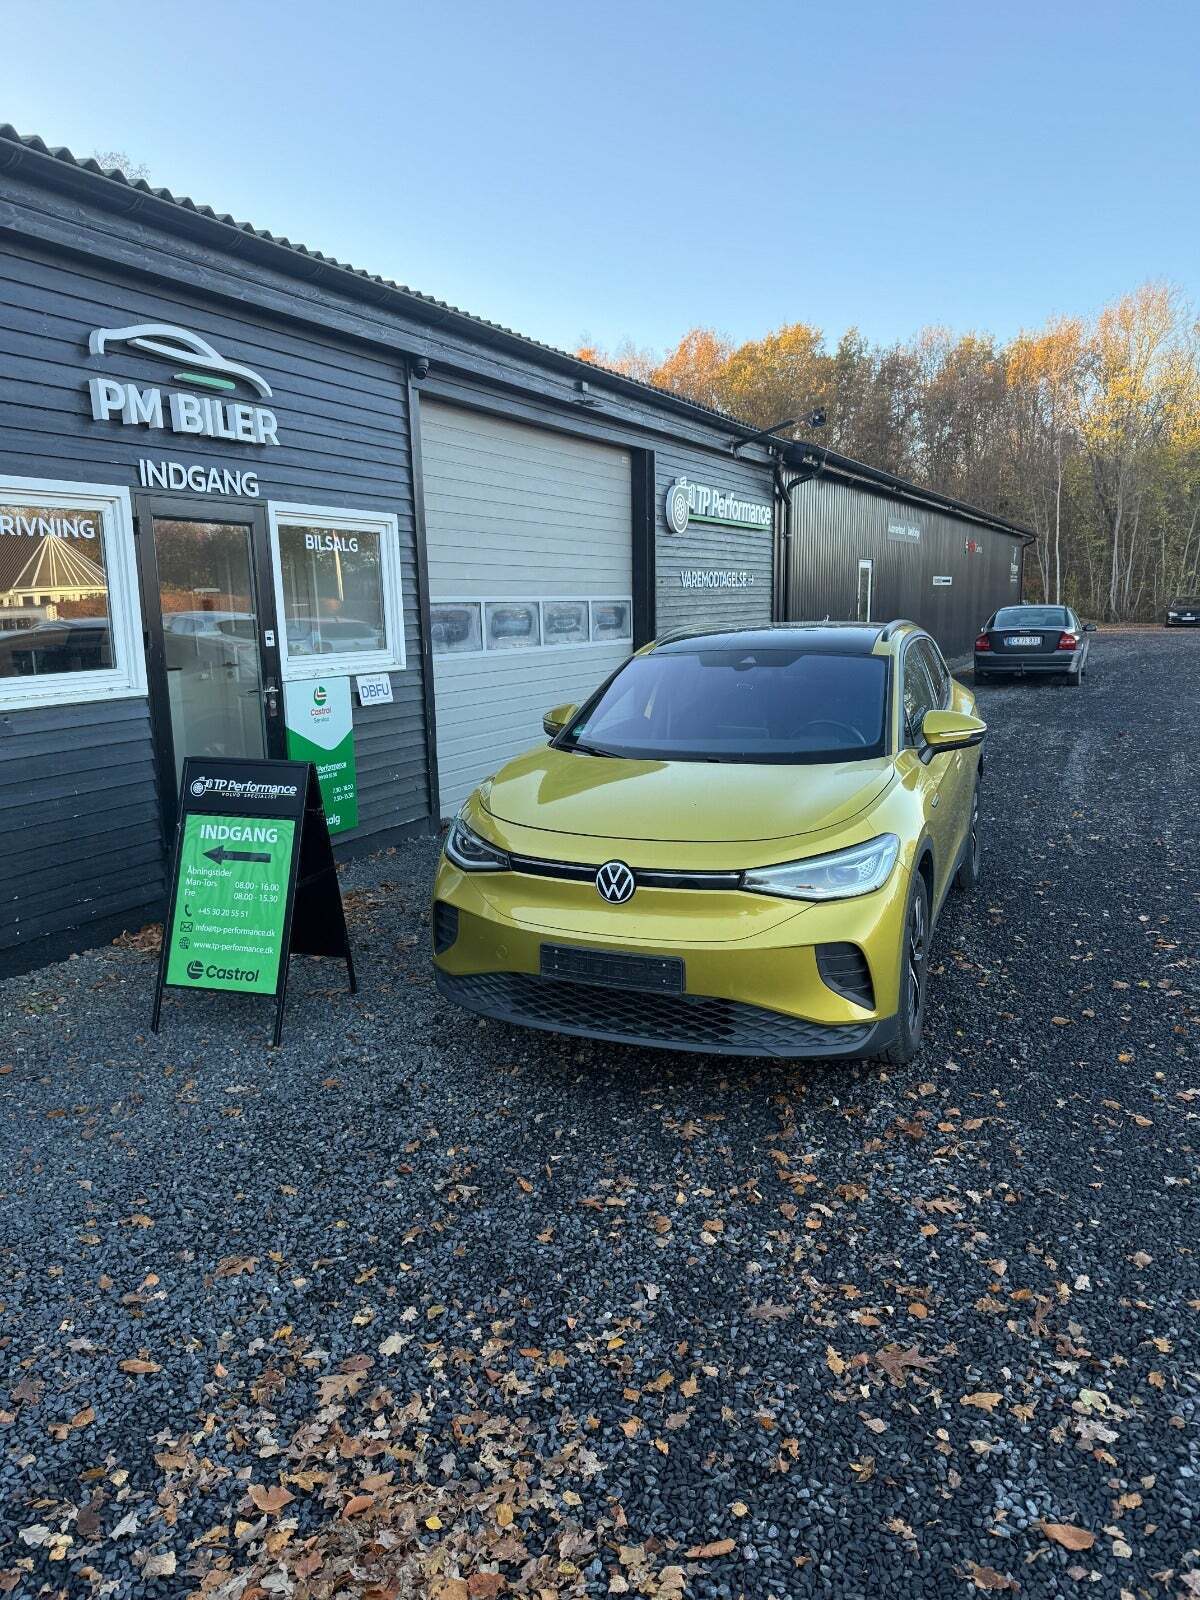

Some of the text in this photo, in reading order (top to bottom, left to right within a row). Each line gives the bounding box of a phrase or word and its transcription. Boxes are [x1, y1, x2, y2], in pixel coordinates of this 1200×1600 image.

[88, 377, 281, 446] PM BILER
[139, 459, 260, 498] INDGANG
[695, 485, 772, 525] TP Performance
[305, 534, 359, 553] BILSALG
[680, 571, 747, 588] VAREMODTAGELSE
[361, 683, 390, 699] DBFU
[310, 706, 332, 717] Castrol
[214, 779, 297, 795] TP Performance
[200, 824, 278, 844] INDGANG
[187, 864, 232, 878] Åbningstider
[193, 941, 274, 955] www.tp-performance.dk
[206, 965, 259, 982] Castrol
